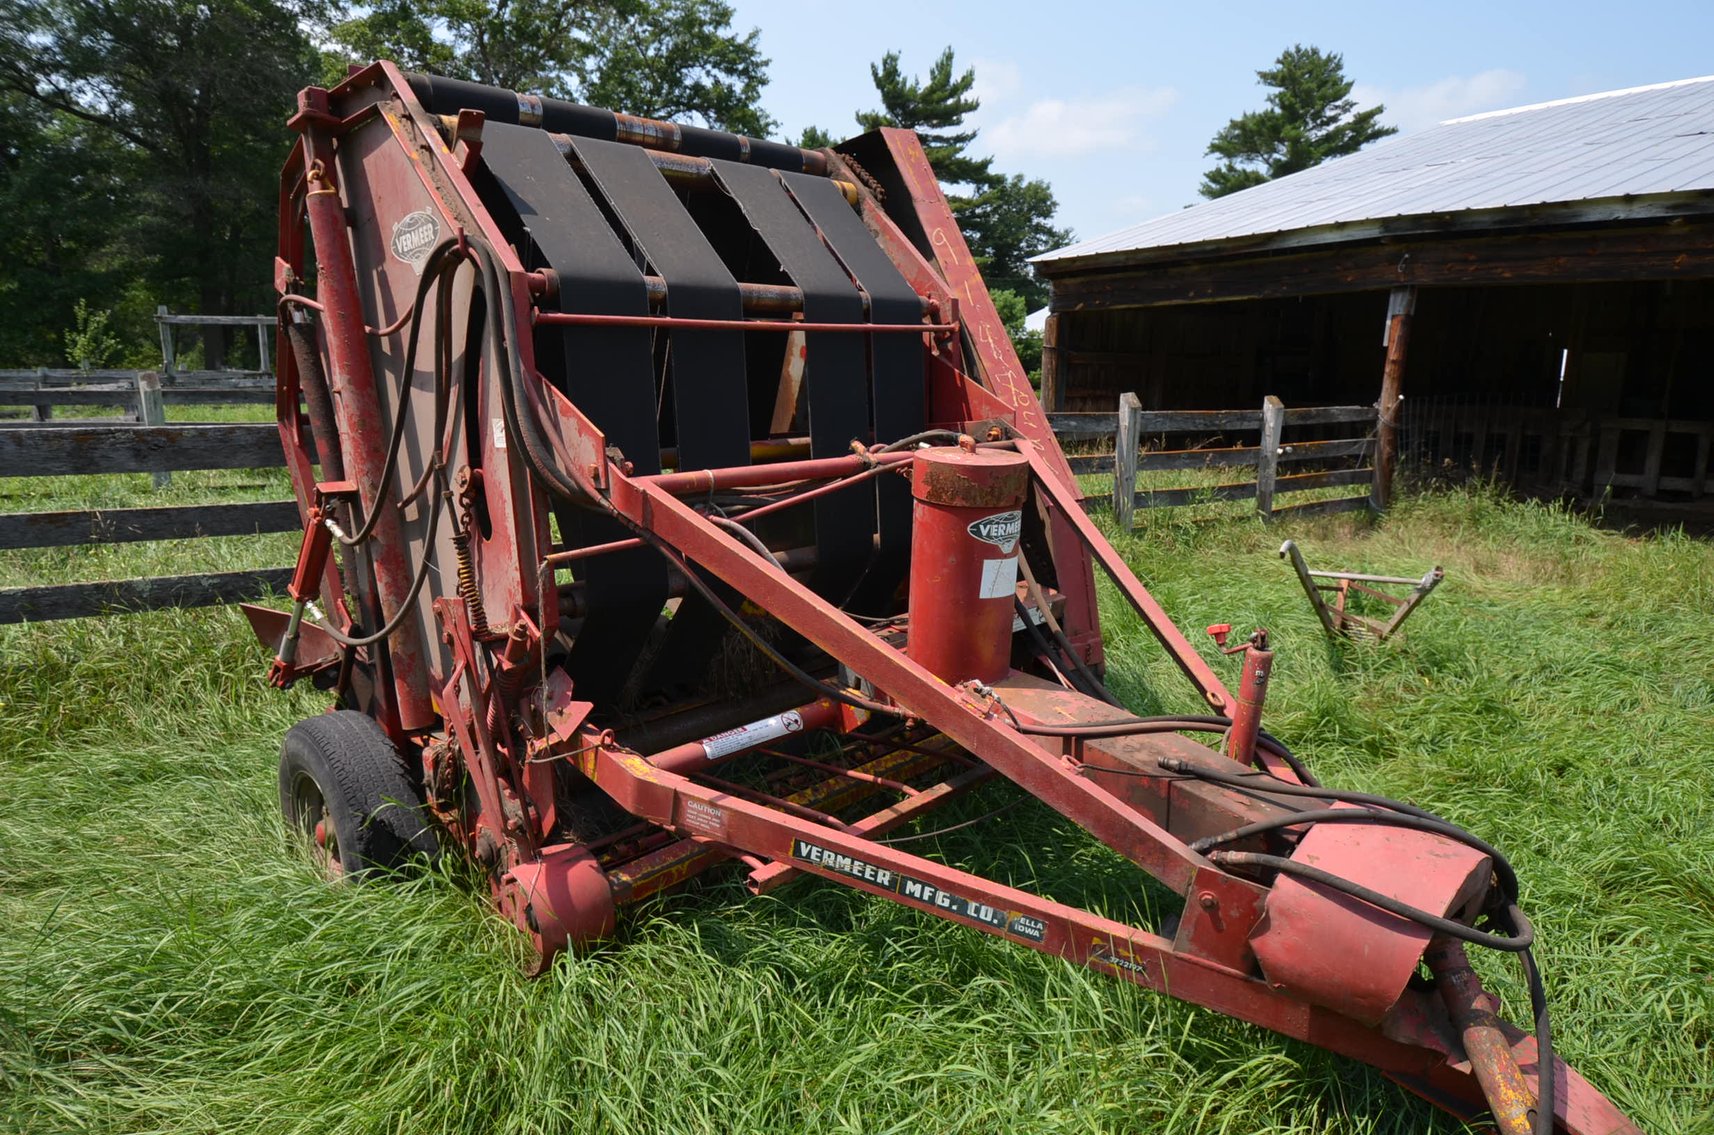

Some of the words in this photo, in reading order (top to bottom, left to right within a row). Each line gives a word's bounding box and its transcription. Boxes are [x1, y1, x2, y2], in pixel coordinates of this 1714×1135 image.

[395, 223, 435, 254] VERMEER
[687, 800, 721, 817] CAUTION
[799, 841, 890, 886] VERMEER
[905, 880, 958, 910] MFG.
[967, 901, 998, 924] CO.
[1014, 923, 1040, 937] IOWA
